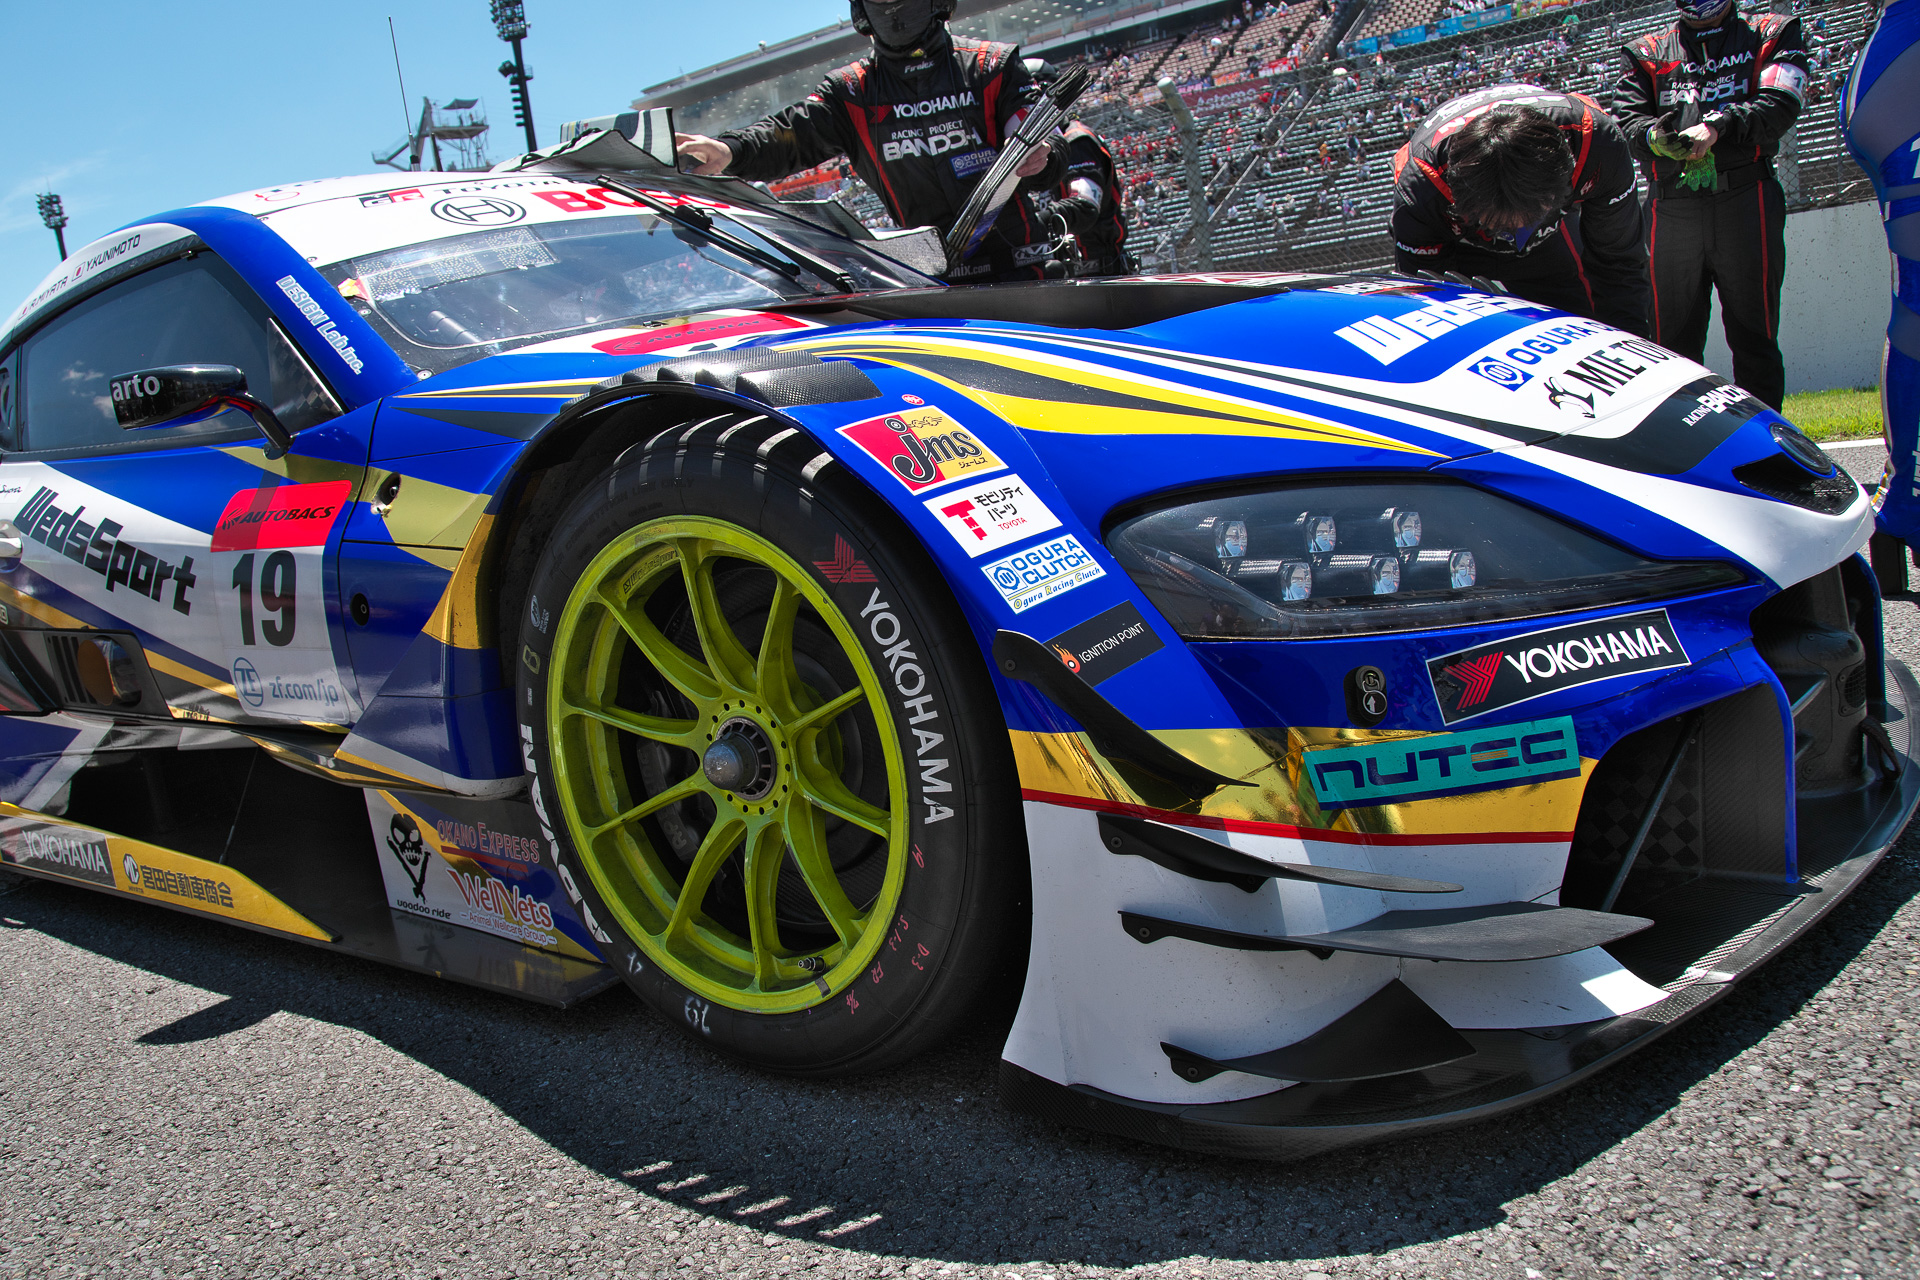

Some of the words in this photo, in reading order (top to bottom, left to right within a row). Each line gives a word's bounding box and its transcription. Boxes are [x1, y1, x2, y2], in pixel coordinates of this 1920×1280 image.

[893, 91, 977, 118] YOKOHAMA
[891, 129, 924, 140] RACING
[929, 119, 963, 135] PROJECT
[433, 180, 561, 195] TOYOTA
[1396, 241, 1439, 256] ADVAN
[275, 274, 331, 327] DESIGN
[1505, 323, 1598, 365] OGURA
[111, 371, 160, 403] arto
[1562, 349, 1648, 397] MIE
[1681, 404, 1712, 427] RACING
[974, 486, 1023, 507] モビリティ
[987, 503, 1018, 521] パーツ
[241, 506, 335, 524] AUTOBACS
[998, 517, 1027, 531] TOYOTA
[13, 485, 197, 616] WedsSport
[1011, 538, 1080, 571] OGURA
[1022, 550, 1091, 585] CLUTCH
[232, 550, 297, 647] 19
[1013, 592, 1043, 610] Ogura
[1045, 578, 1074, 596] Racing
[1075, 566, 1101, 582] Clutch
[1078, 635, 1120, 664] IGNITION
[1117, 622, 1145, 645] POINT
[1505, 625, 1673, 684] YOKOHAMA
[269, 676, 339, 707] zf.com/jp
[859, 586, 955, 825] YOKOHAMA
[437, 819, 477, 849] OKANO
[21, 829, 109, 875] YOKOHAMA
[140, 865, 234, 909] 宮田自動車商会
[445, 867, 555, 932] WellVets
[396, 899, 430, 915] voodoo
[432, 907, 451, 920] ride
[469, 912, 491, 926] Animal
[493, 919, 522, 936] Wellcare
[524, 927, 547, 943] Group
